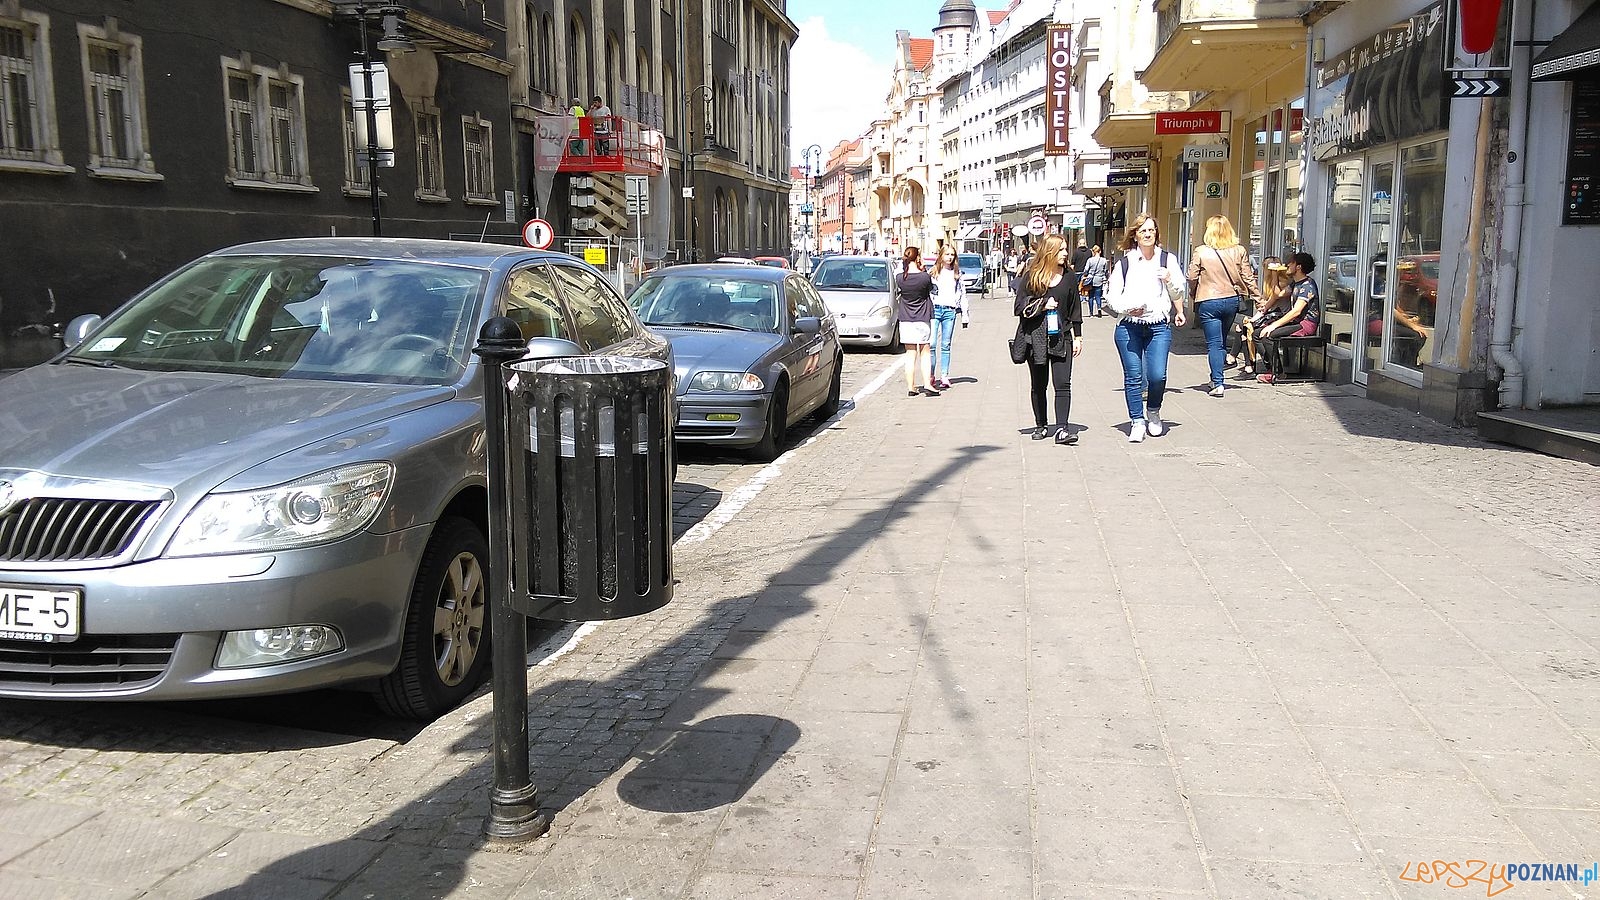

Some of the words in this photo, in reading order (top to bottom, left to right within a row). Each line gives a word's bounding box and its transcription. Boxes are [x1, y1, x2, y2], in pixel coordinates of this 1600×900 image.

[1052, 31, 1069, 147] HOSTEL
[1162, 118, 1205, 130] Triumph
[1188, 149, 1224, 159] felina
